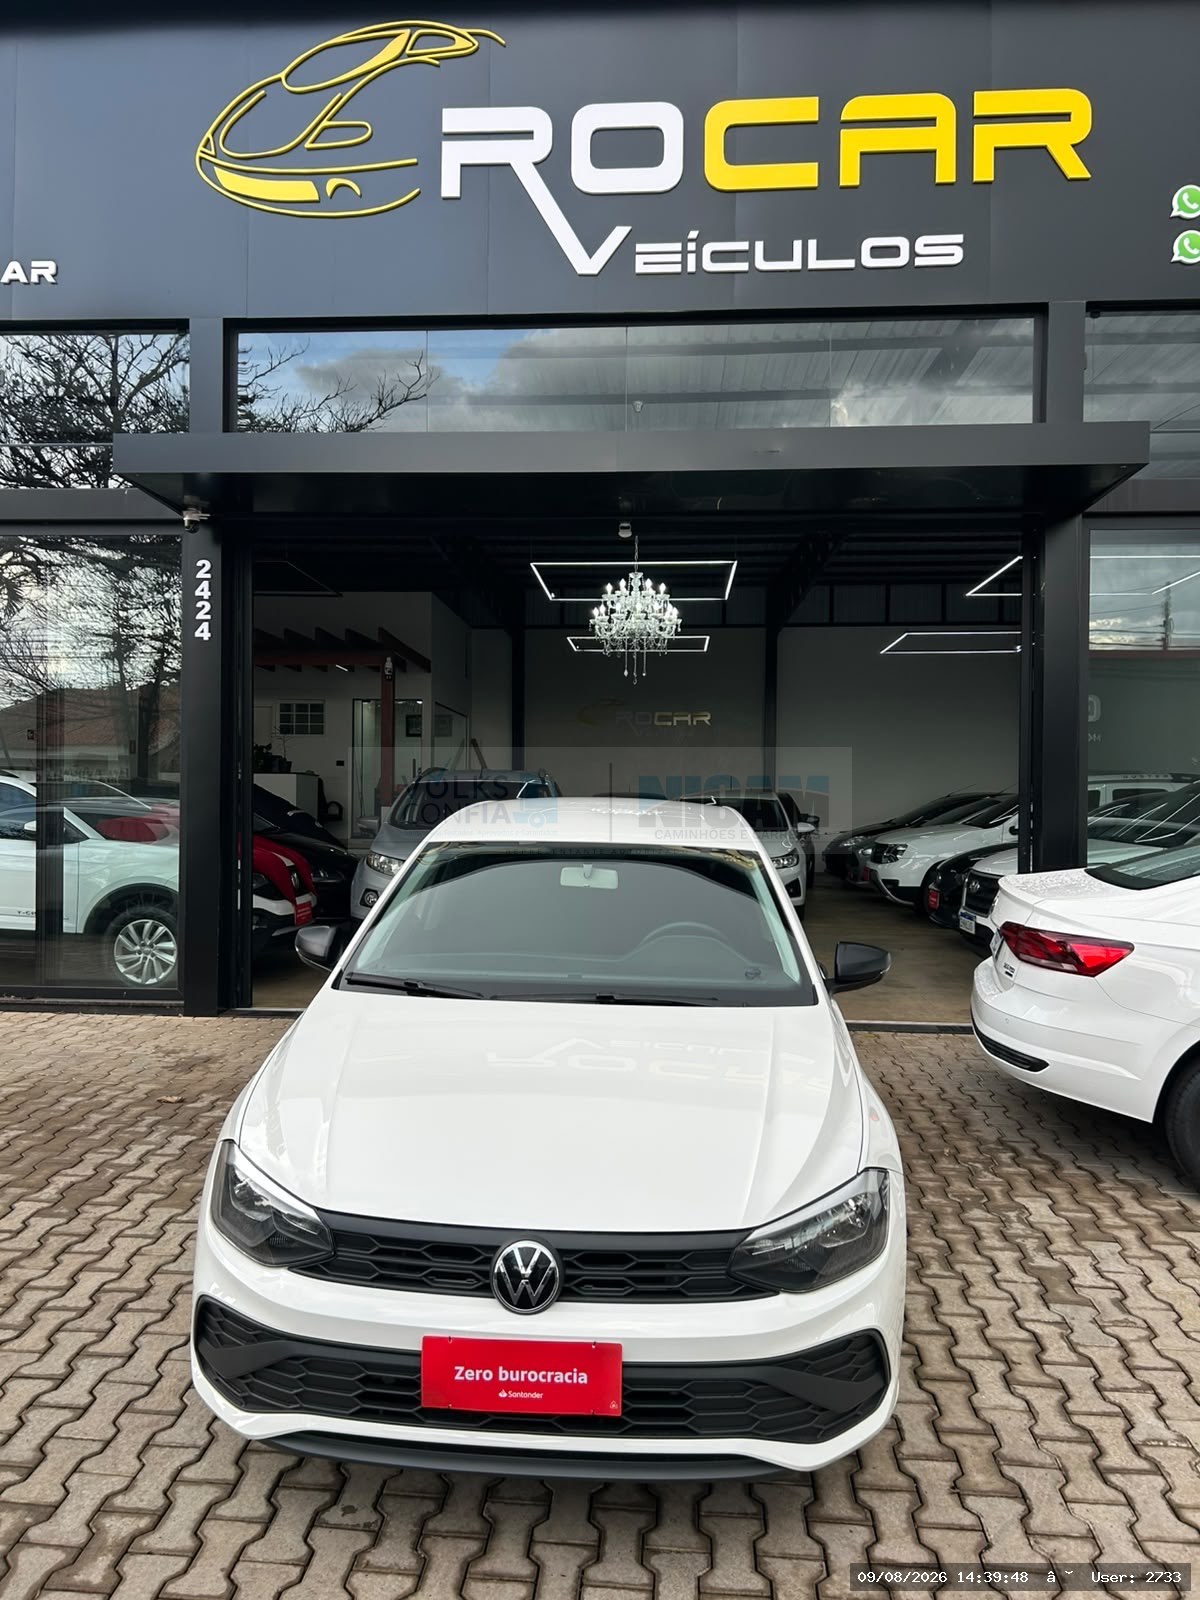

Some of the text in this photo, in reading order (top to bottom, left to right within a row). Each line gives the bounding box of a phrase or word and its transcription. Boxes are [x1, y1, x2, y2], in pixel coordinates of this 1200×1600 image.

[441, 88, 1092, 198] ROCAR
[552, 225, 964, 275] VEÍCULOS
[194, 559, 212, 641] 2424
[615, 711, 711, 727] ROCAR
[453, 1366, 588, 1384] Zero burocracia
[507, 1389, 544, 1400] Santander
